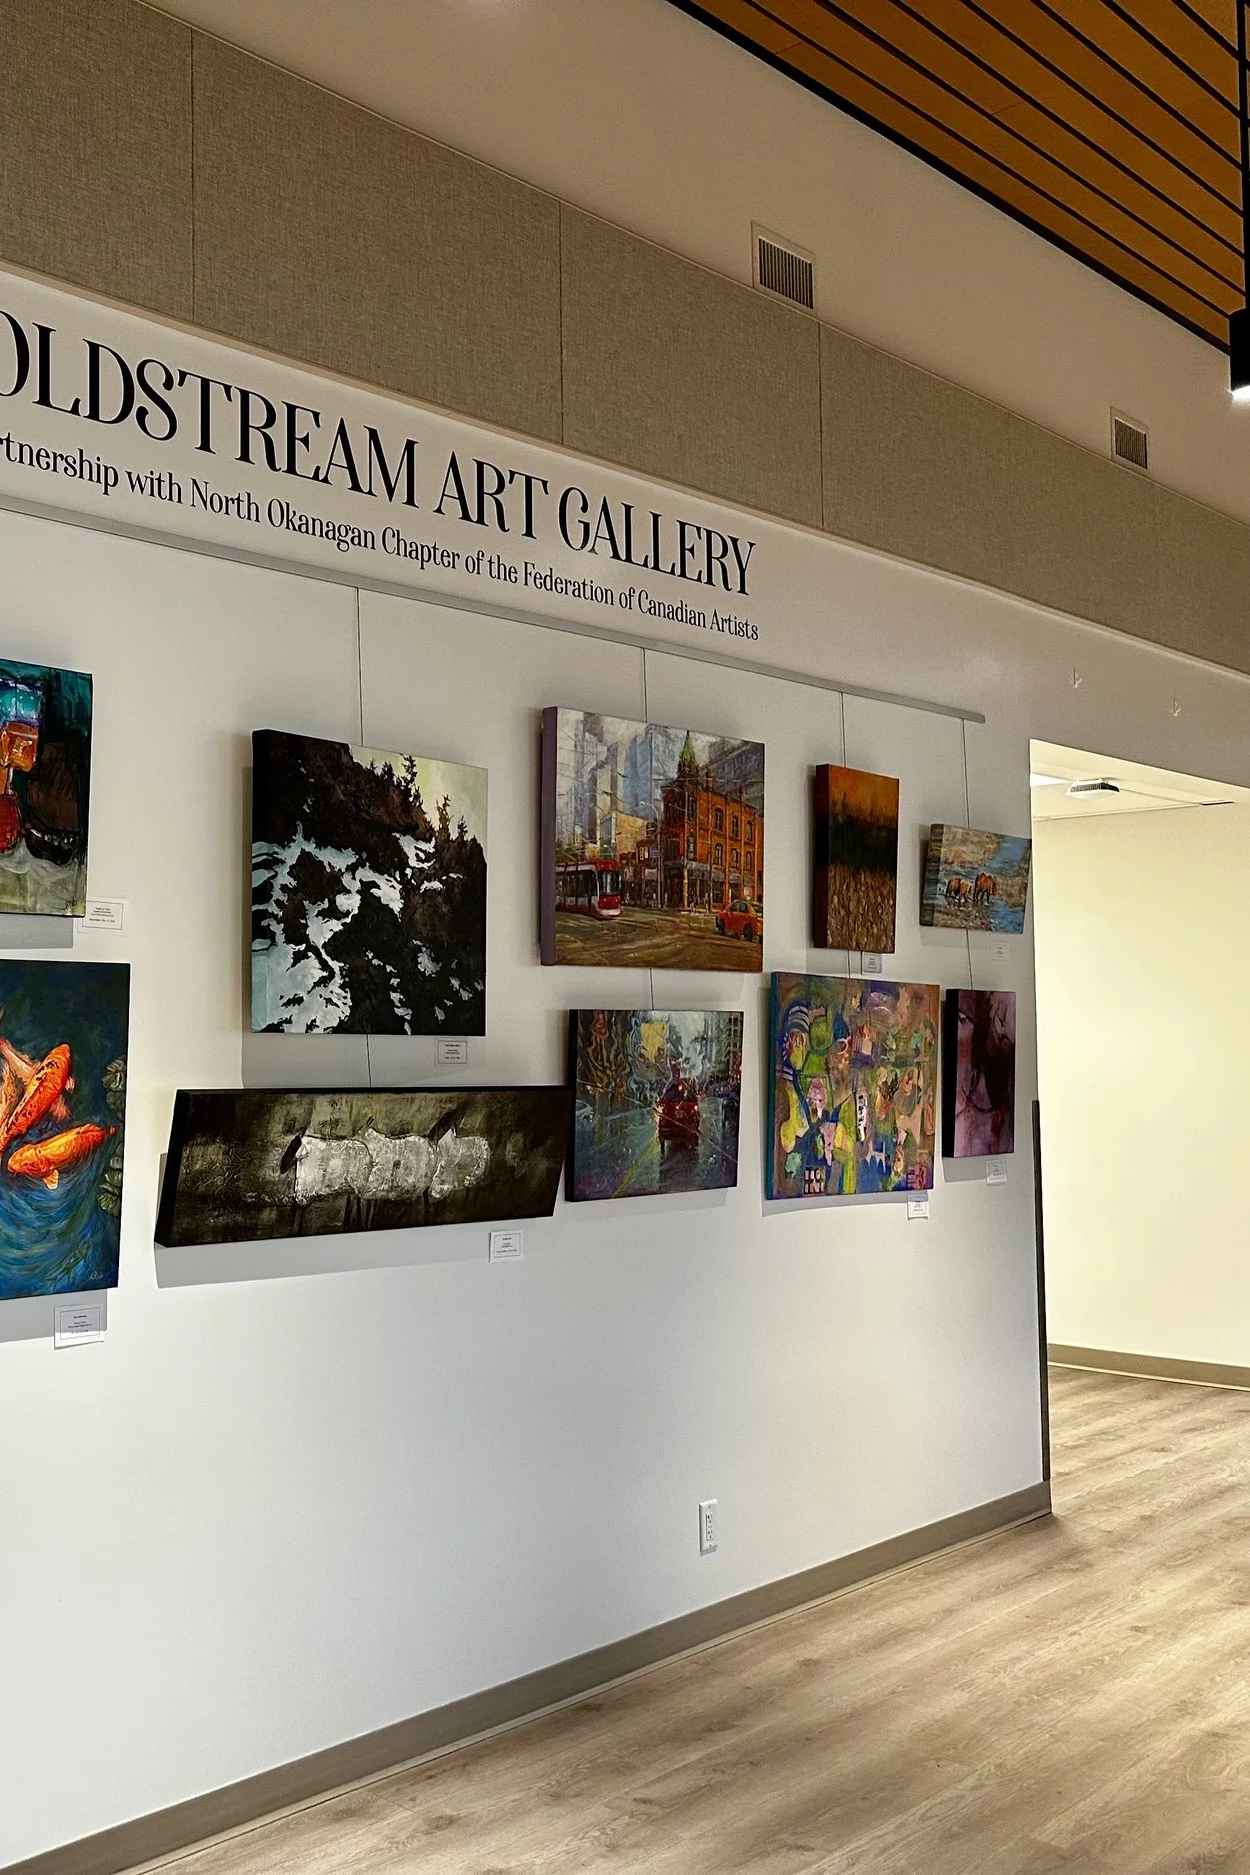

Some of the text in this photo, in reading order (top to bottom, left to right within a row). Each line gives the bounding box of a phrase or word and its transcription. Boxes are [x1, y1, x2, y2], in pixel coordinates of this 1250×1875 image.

[125, 468, 183, 505] with
[190, 478, 261, 523] North
[267, 499, 376, 552] Okanagan
[382, 527, 460, 571] Chapter
[465, 550, 484, 576] of
[487, 555, 518, 584] the
[523, 562, 614, 607] Federation
[618, 587, 637, 611] of
[637, 589, 707, 629] Canadian
[710, 609, 759, 641] Artists
[433, 451, 549, 539] ART
[558, 486, 756, 596] GALLERY
